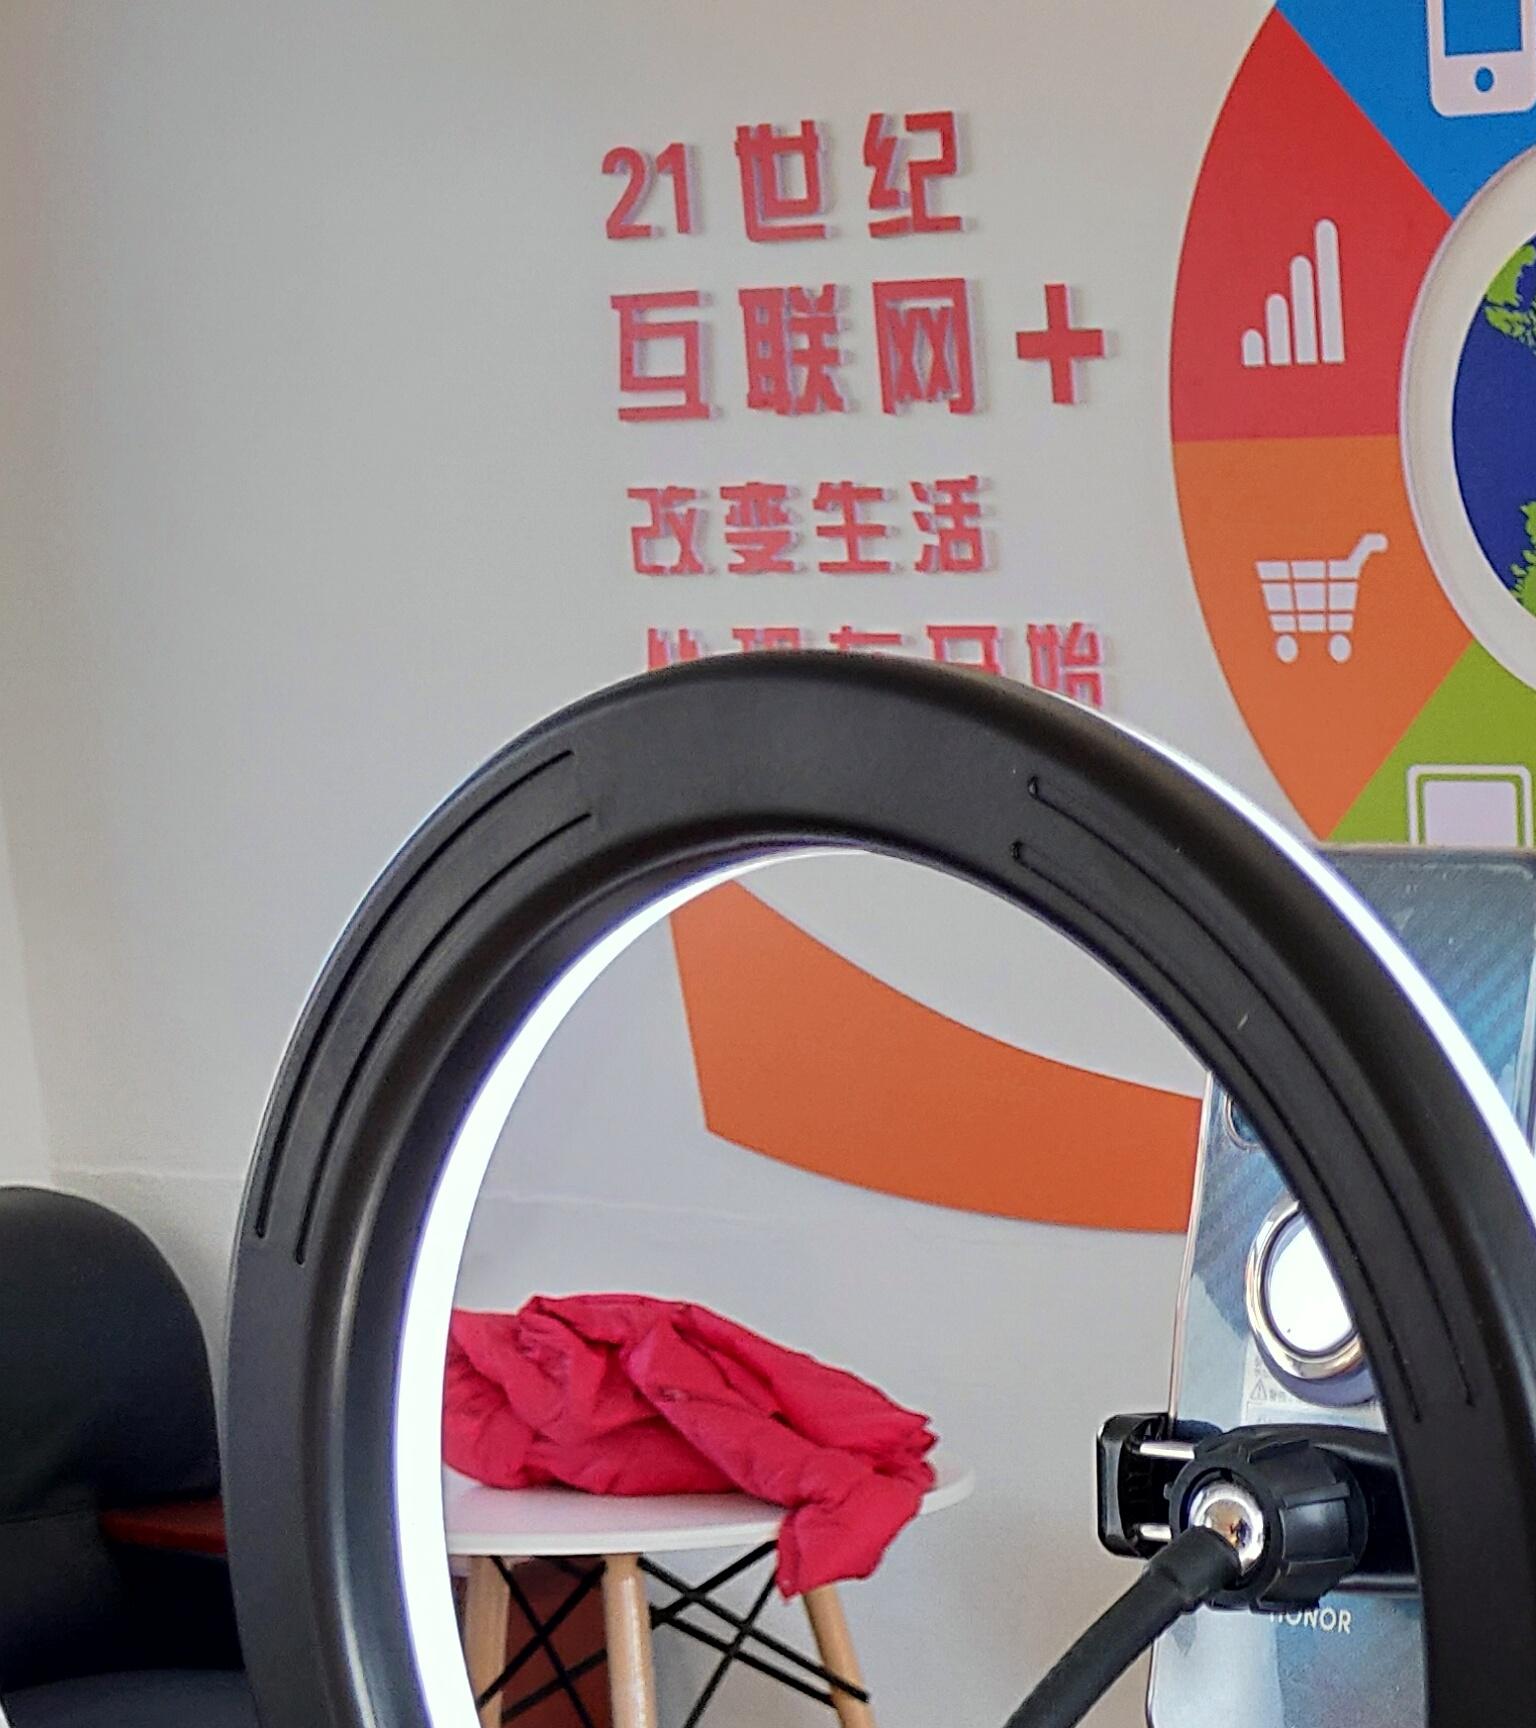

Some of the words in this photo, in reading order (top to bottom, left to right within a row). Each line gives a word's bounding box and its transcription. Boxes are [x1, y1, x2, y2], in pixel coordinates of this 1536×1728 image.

[602, 111, 966, 241] 21世纪
[628, 476, 985, 575] 改变生活
